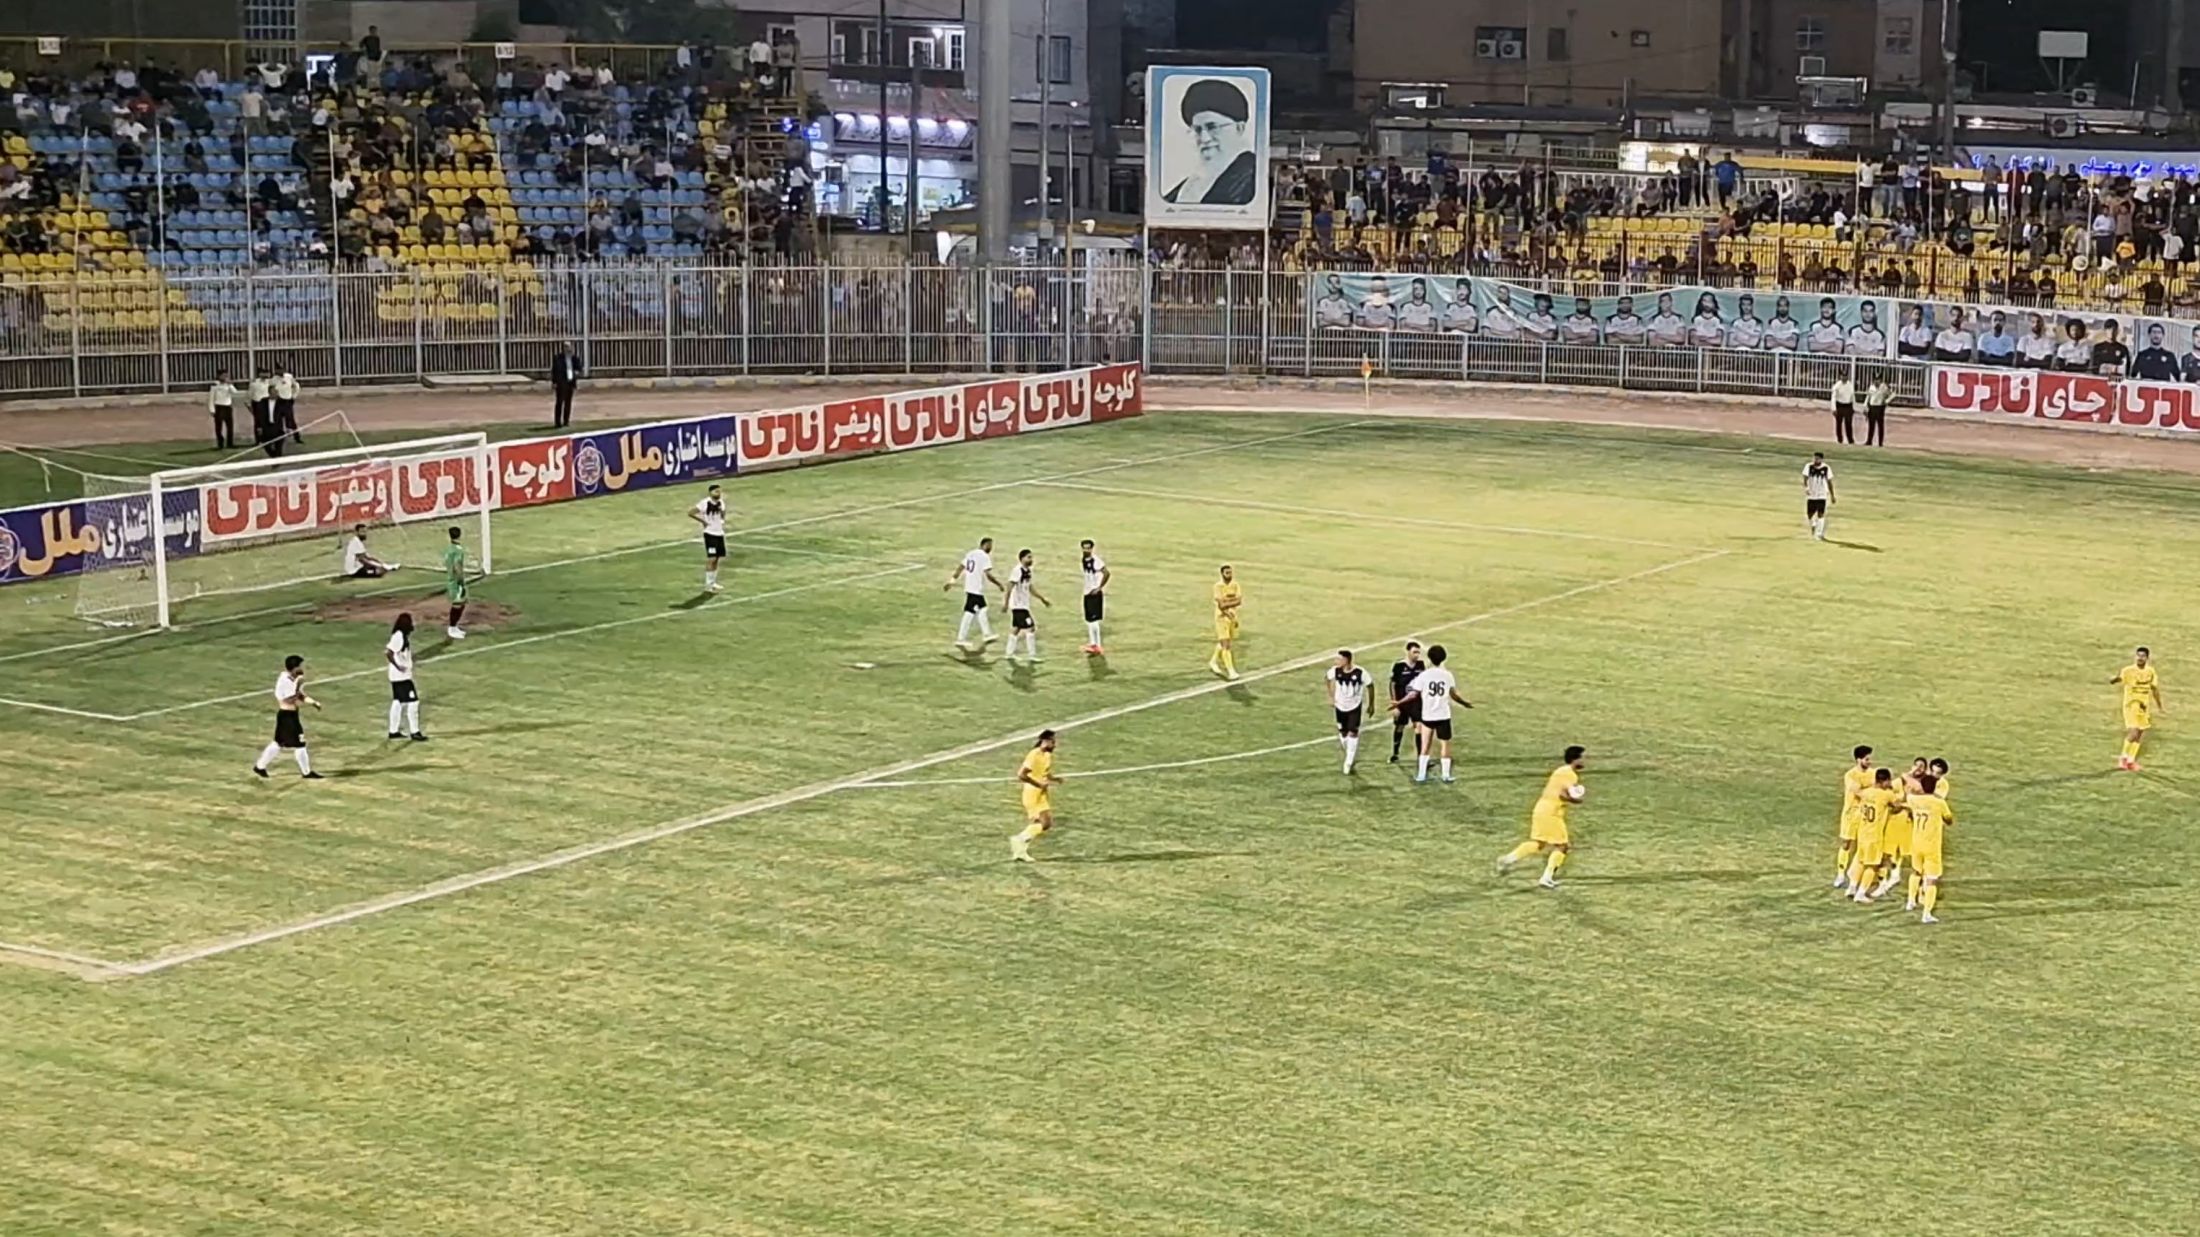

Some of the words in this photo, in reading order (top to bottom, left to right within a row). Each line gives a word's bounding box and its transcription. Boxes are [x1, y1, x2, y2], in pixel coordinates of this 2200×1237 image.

[970, 388, 1016, 435] چای
[1094, 369, 1137, 412] کلوچه
[2042, 378, 2106, 422] چای
[829, 404, 882, 449] ویفر
[503, 444, 568, 499] کلوچه
[603, 431, 663, 490] ملل
[322, 469, 387, 522] ویفر
[18, 506, 102, 576] ملل
[1428, 681, 1446, 697] 96
